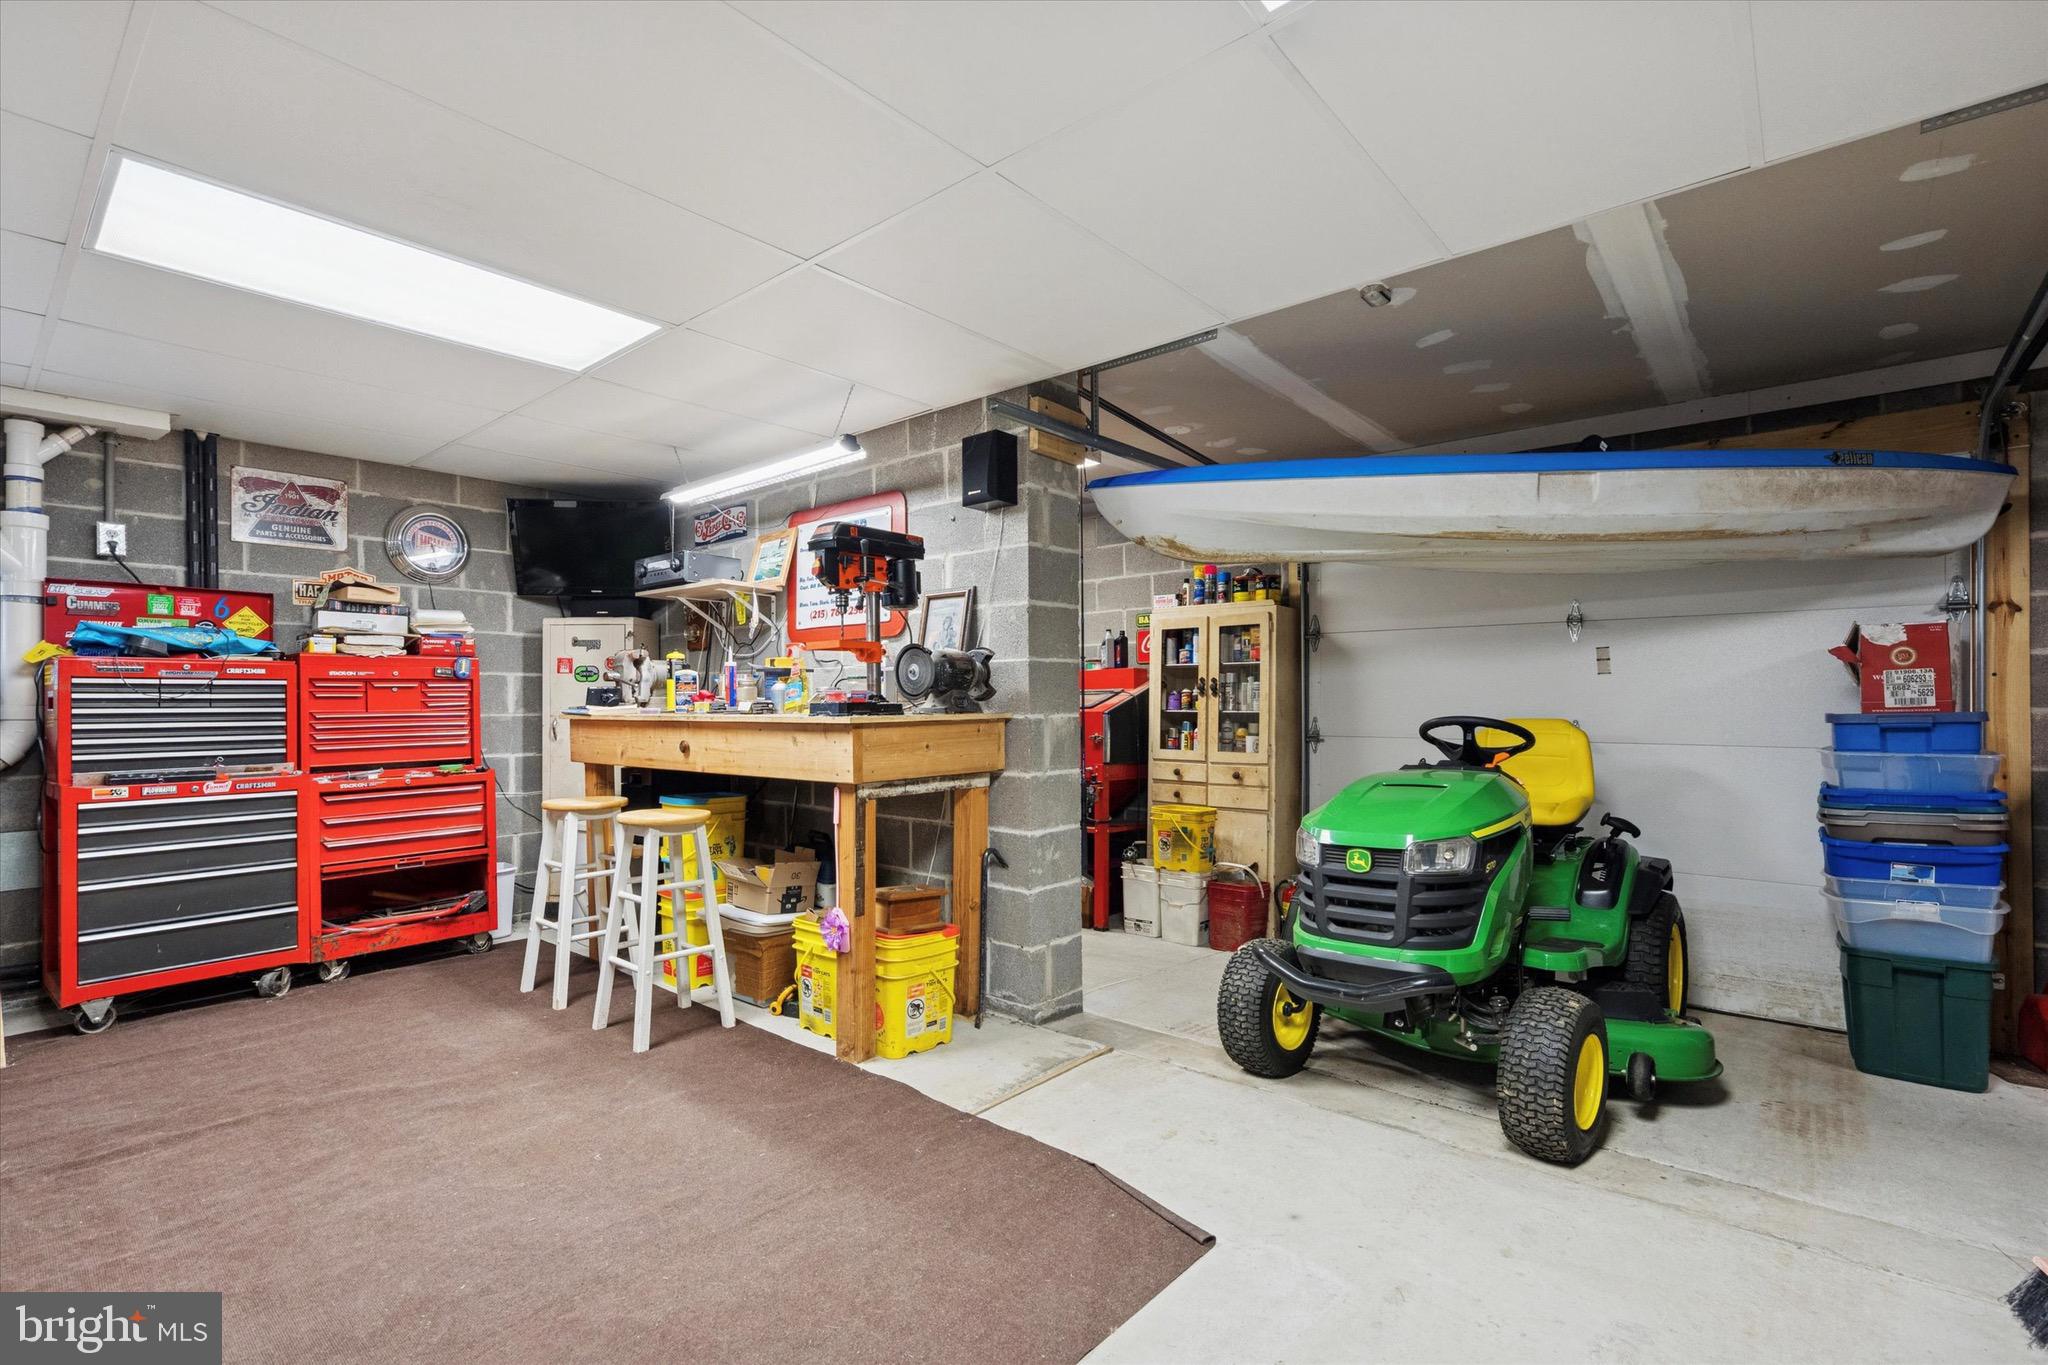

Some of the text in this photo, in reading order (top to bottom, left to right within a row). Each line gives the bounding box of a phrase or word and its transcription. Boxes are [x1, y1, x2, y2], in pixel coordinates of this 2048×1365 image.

[241, 494, 339, 520] Indian
[271, 523, 312, 534] GENUINE
[285, 531, 327, 543] ACCESSORIES
[213, 596, 232, 619] 6
[810, 609, 828, 621] (215)
[1917, 688, 1934, 697] 5629
[235, 782, 277, 790] CRAFTSMAN
